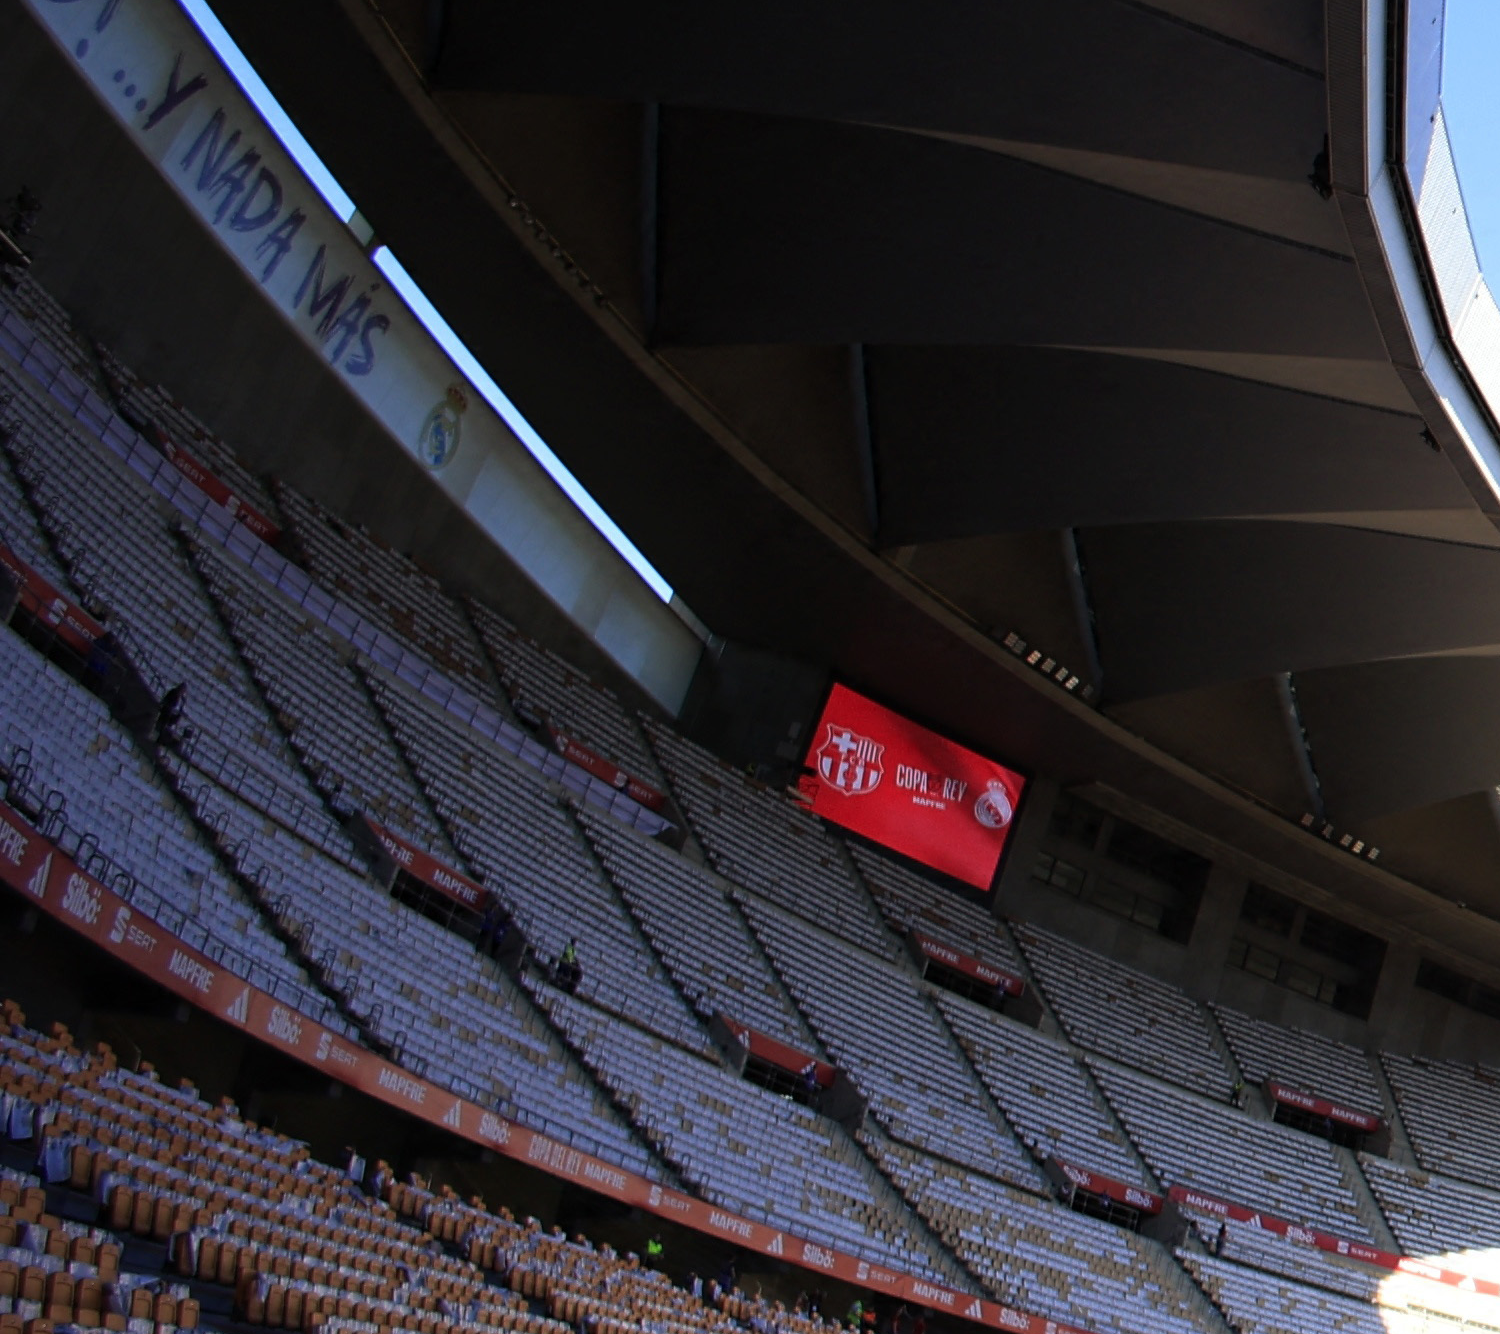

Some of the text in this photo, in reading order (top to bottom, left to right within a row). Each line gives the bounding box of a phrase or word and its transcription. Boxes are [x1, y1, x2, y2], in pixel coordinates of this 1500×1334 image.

[182, 107, 307, 282] NADA
[293, 244, 390, 377] MÁS
[896, 763, 967, 803] COPA REY
[433, 868, 479, 905] MAPFRE
[0, 818, 29, 866] PFRE
[127, 923, 158, 952] SEAT
[169, 948, 215, 993] MAPFRE
[378, 1067, 427, 1104] MAPFRE
[584, 1162, 627, 1191] MAPFRE
[709, 1210, 754, 1239] MAPFRE
[912, 1281, 956, 1306] MAPFRE
[1186, 1193, 1229, 1215] MAPFRE
